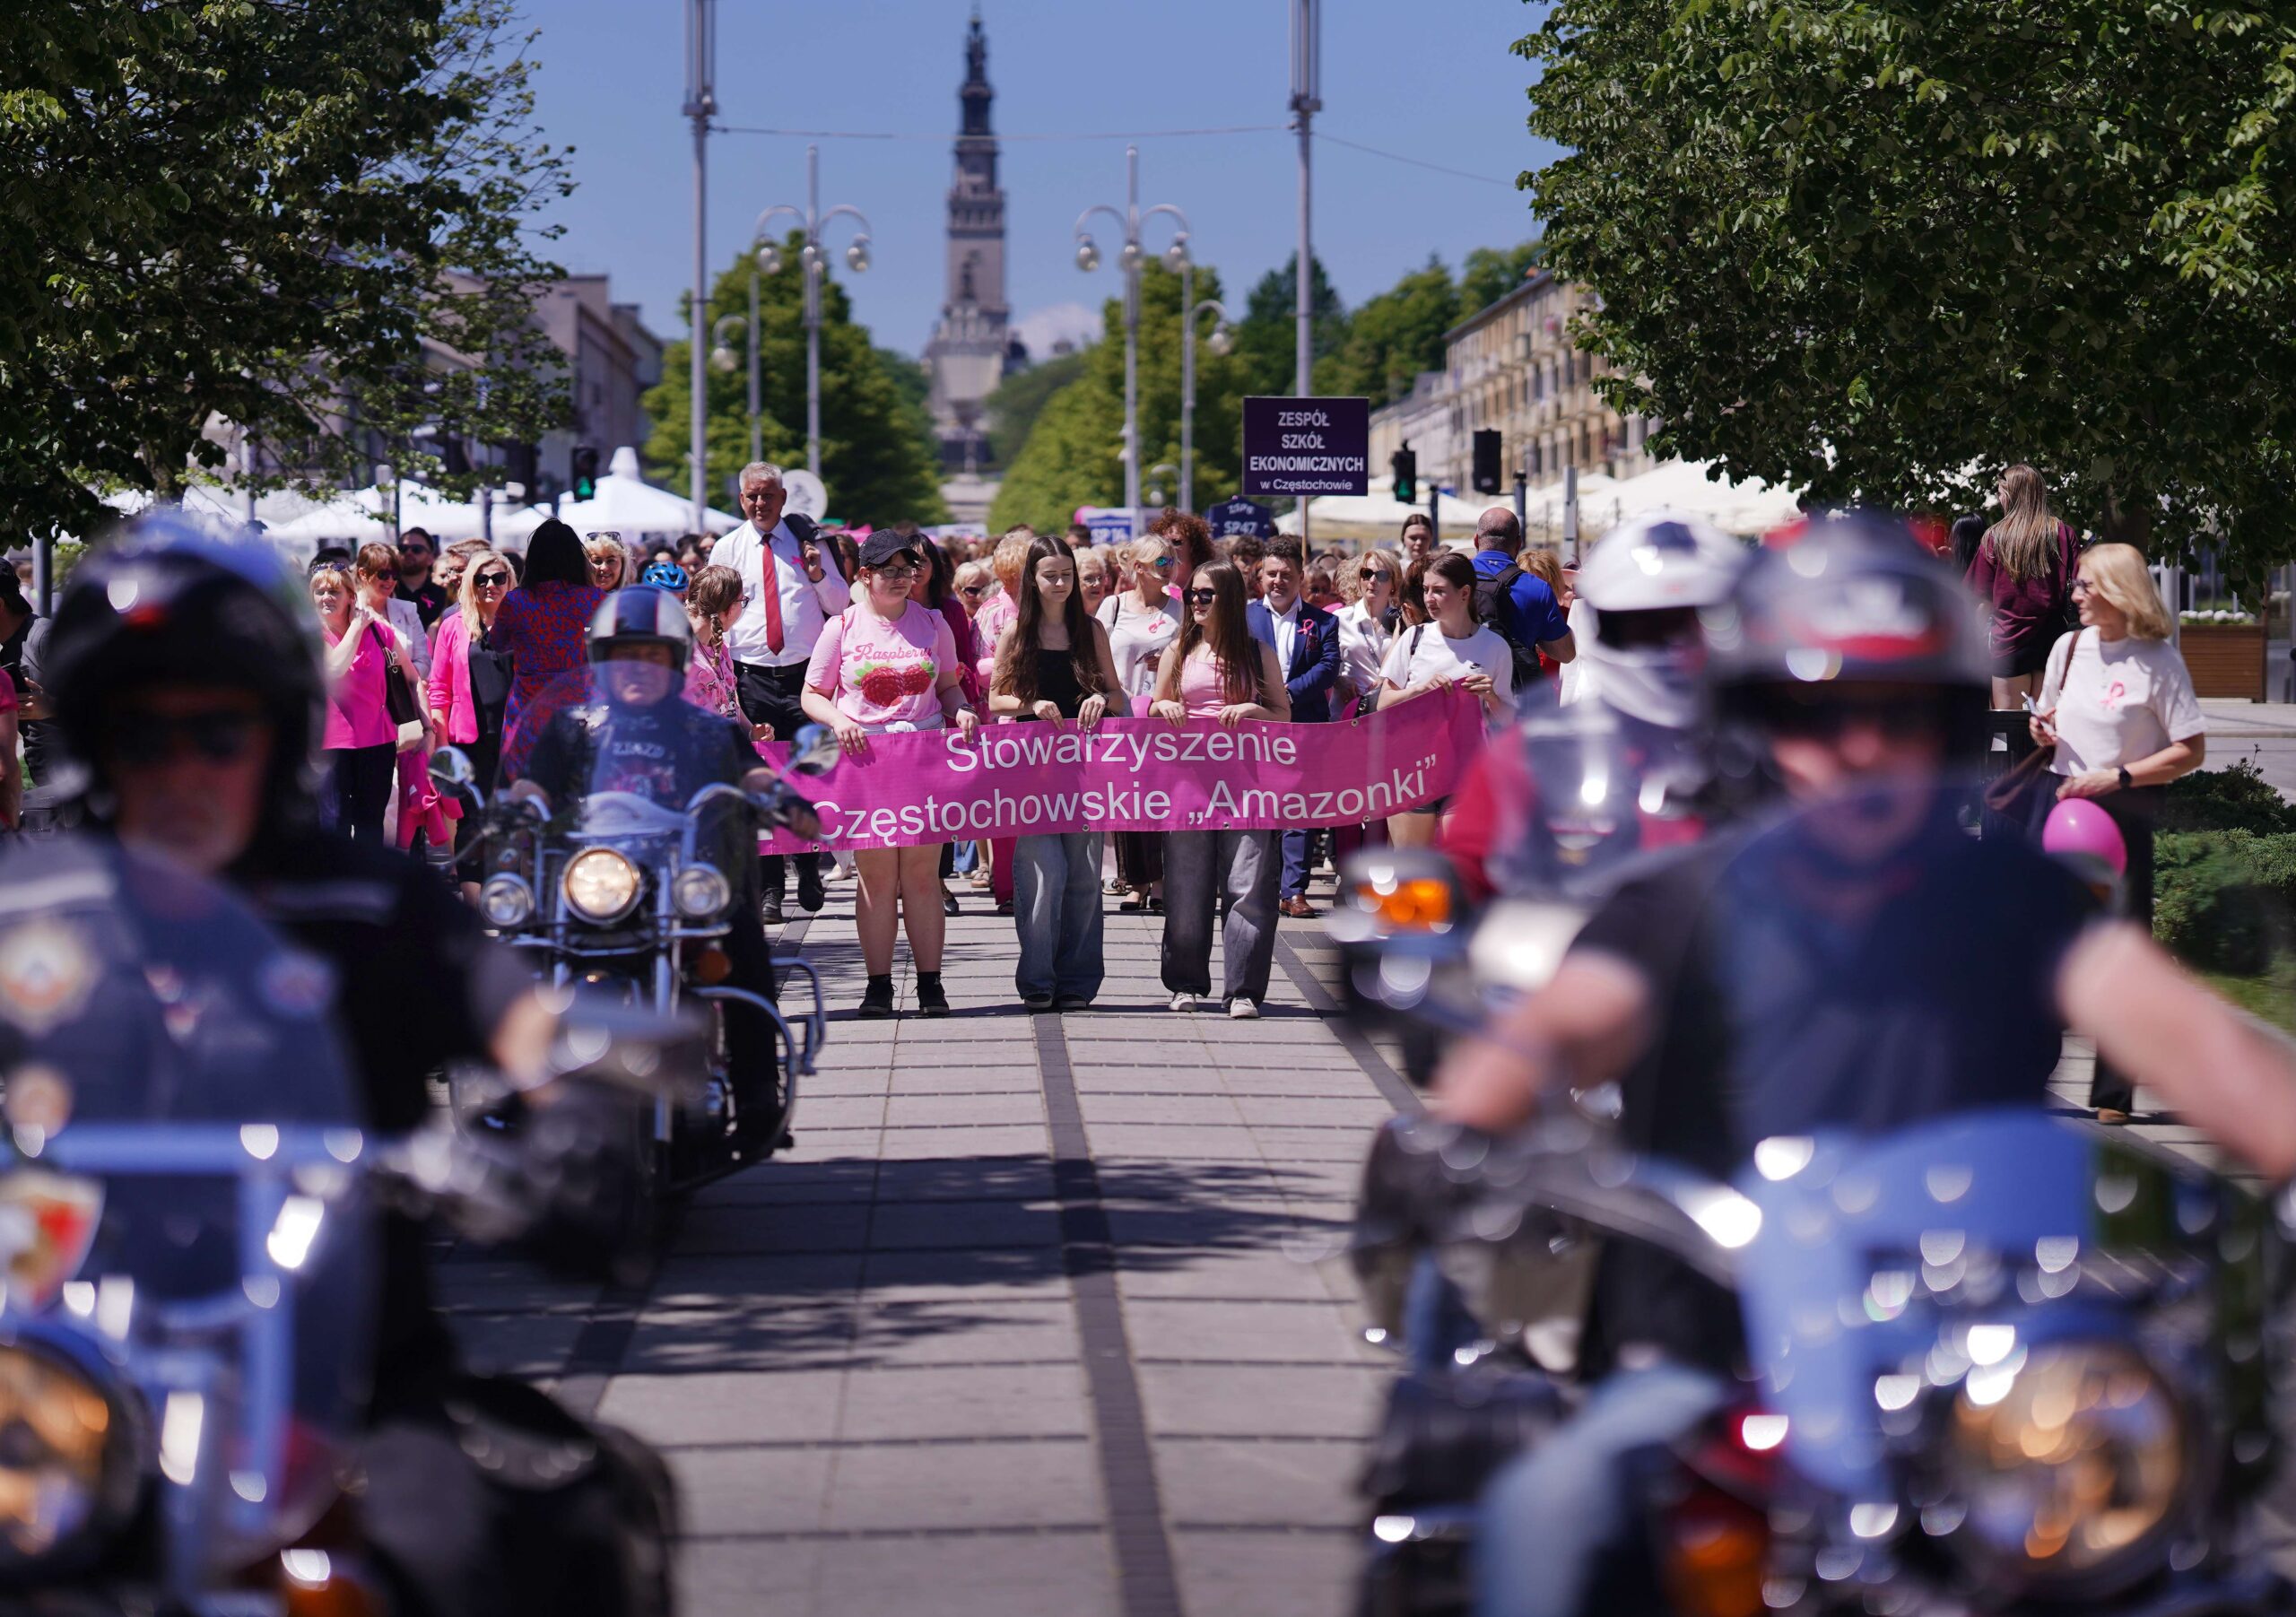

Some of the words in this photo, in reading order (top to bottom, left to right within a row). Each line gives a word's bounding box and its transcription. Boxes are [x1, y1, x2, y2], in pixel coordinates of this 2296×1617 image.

[1278, 409, 1330, 427] ZESPÓŁ
[1281, 431, 1326, 449] SZKÓŁ
[1249, 456, 1364, 472] EKONOMICZNYCH
[1260, 481, 1271, 490] w
[1273, 478, 1353, 492] Częstochowie
[853, 642, 933, 662] Raspberry
[946, 726, 1297, 772] Stowarzyszenie
[812, 780, 1171, 847] Częstochowskie
